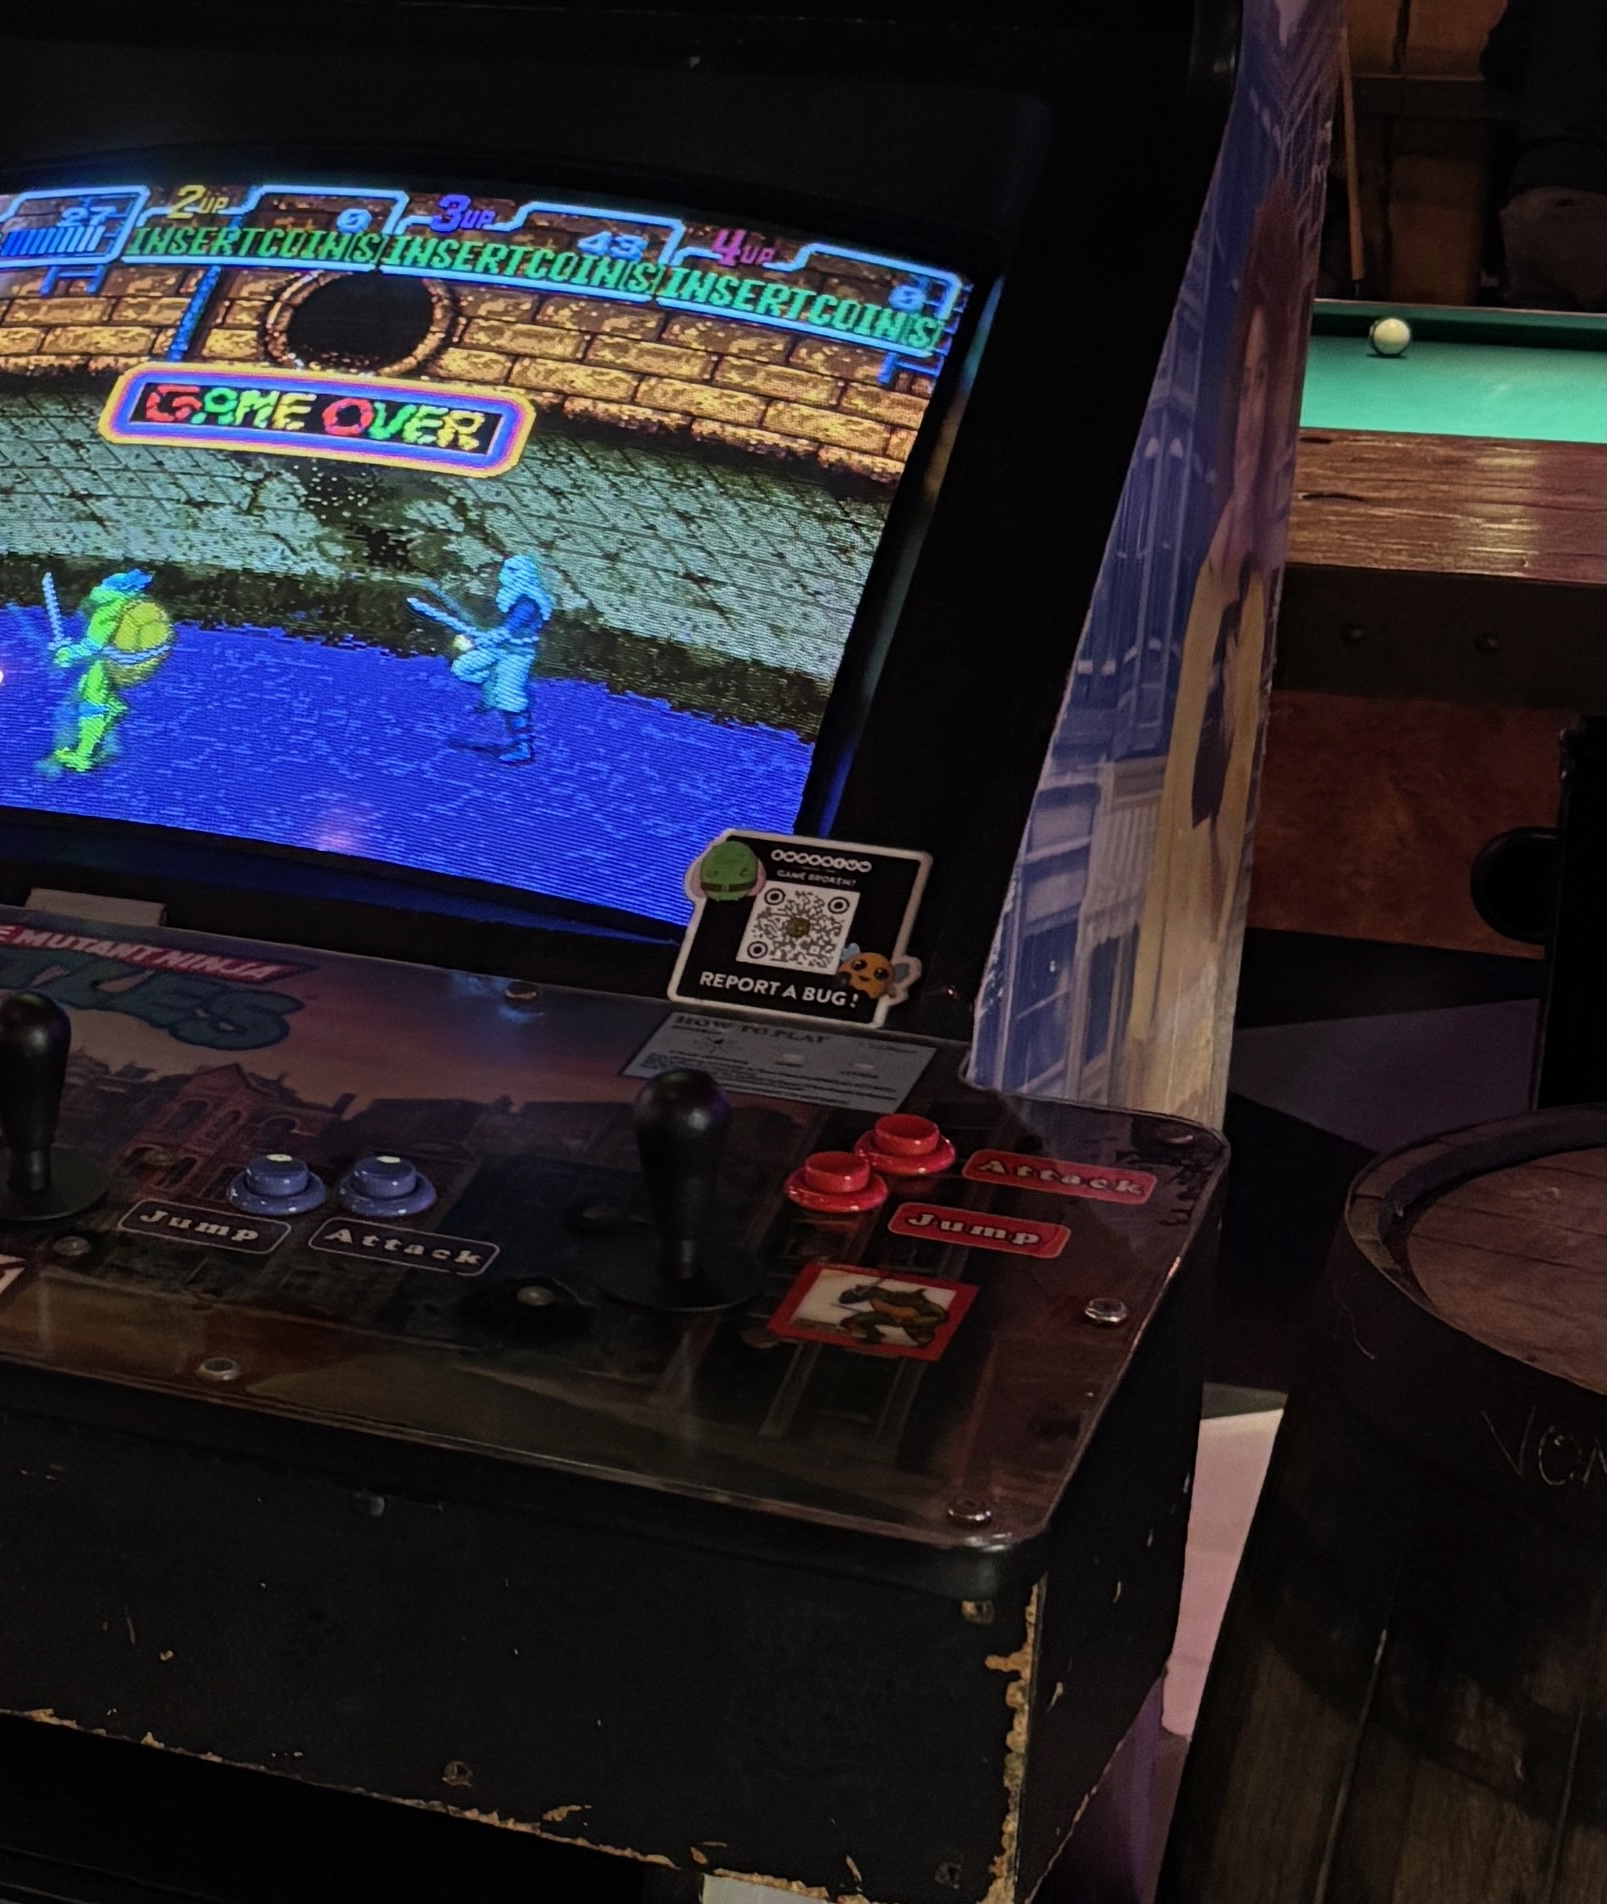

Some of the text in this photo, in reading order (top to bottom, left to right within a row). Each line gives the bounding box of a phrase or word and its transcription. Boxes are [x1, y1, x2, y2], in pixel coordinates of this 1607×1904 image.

[168, 184, 230, 220] 2UP
[430, 194, 496, 233] 3UP
[711, 228, 776, 269] 4UP
[145, 384, 486, 452] GAME OVER
[16, 926, 155, 964] MUTANT
[157, 948, 286, 982] NINJA
[699, 970, 781, 998] REPORT
[782, 984, 797, 1002] A
[976, 1159, 1142, 1195] Attack
[139, 1210, 260, 1243] Jump
[907, 1213, 1040, 1245] Jump
[323, 1228, 482, 1266] Attack
